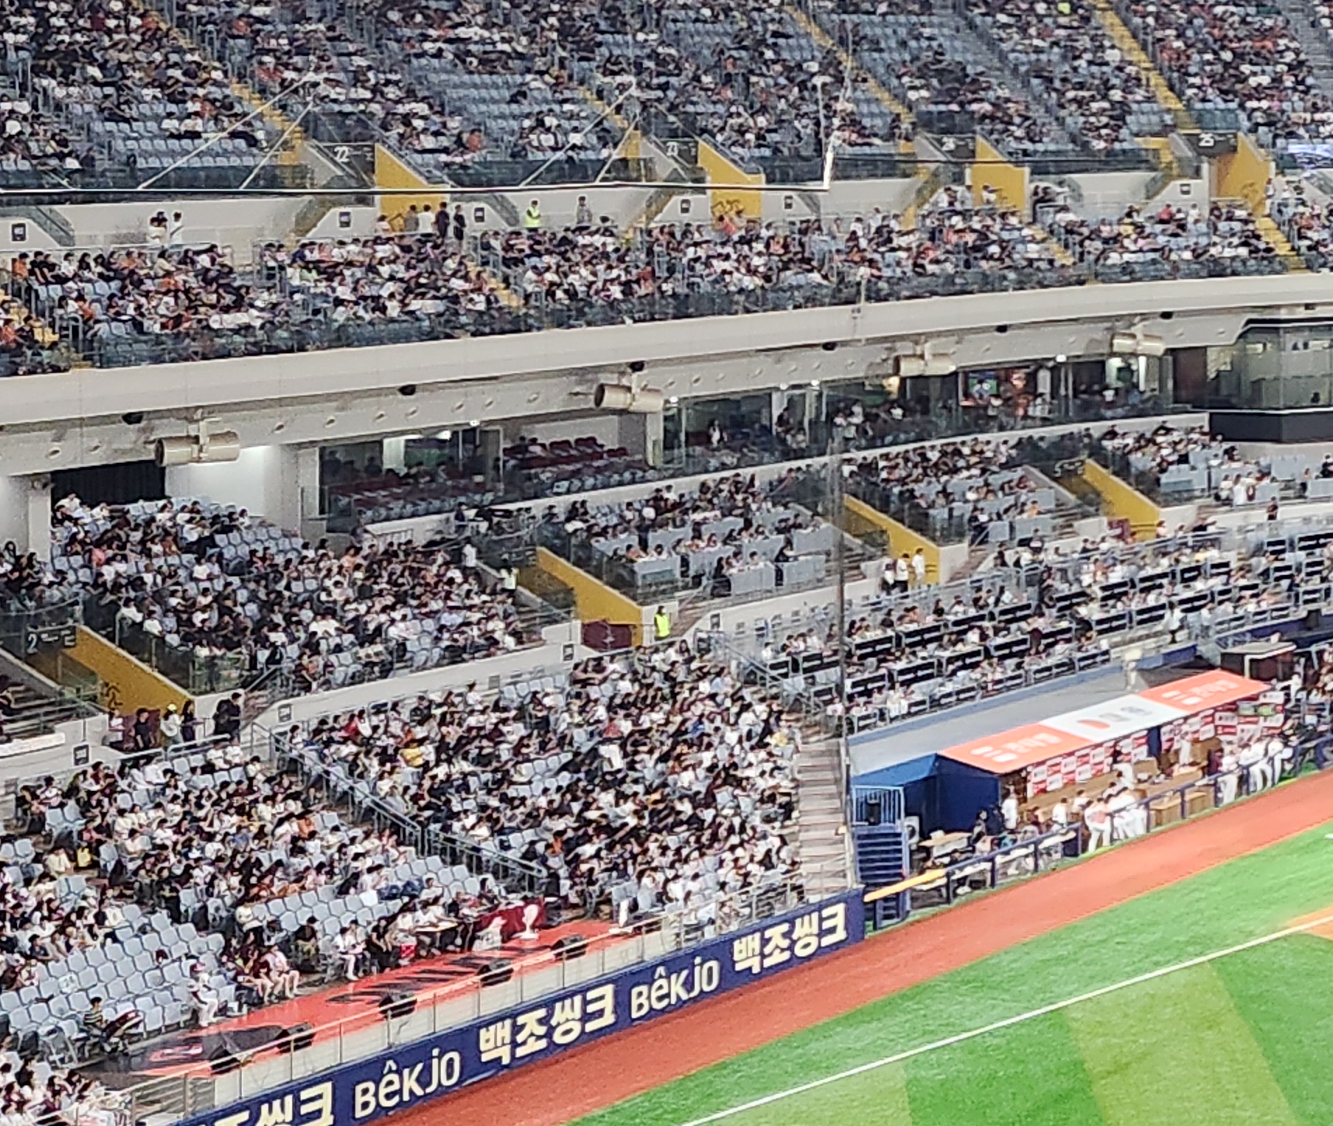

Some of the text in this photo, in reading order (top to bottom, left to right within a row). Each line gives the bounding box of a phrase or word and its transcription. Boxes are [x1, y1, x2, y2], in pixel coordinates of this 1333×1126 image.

[334, 147, 350, 162] 22
[479, 983, 617, 1066] 백조씽크
[732, 902, 848, 974] 백조씽크
